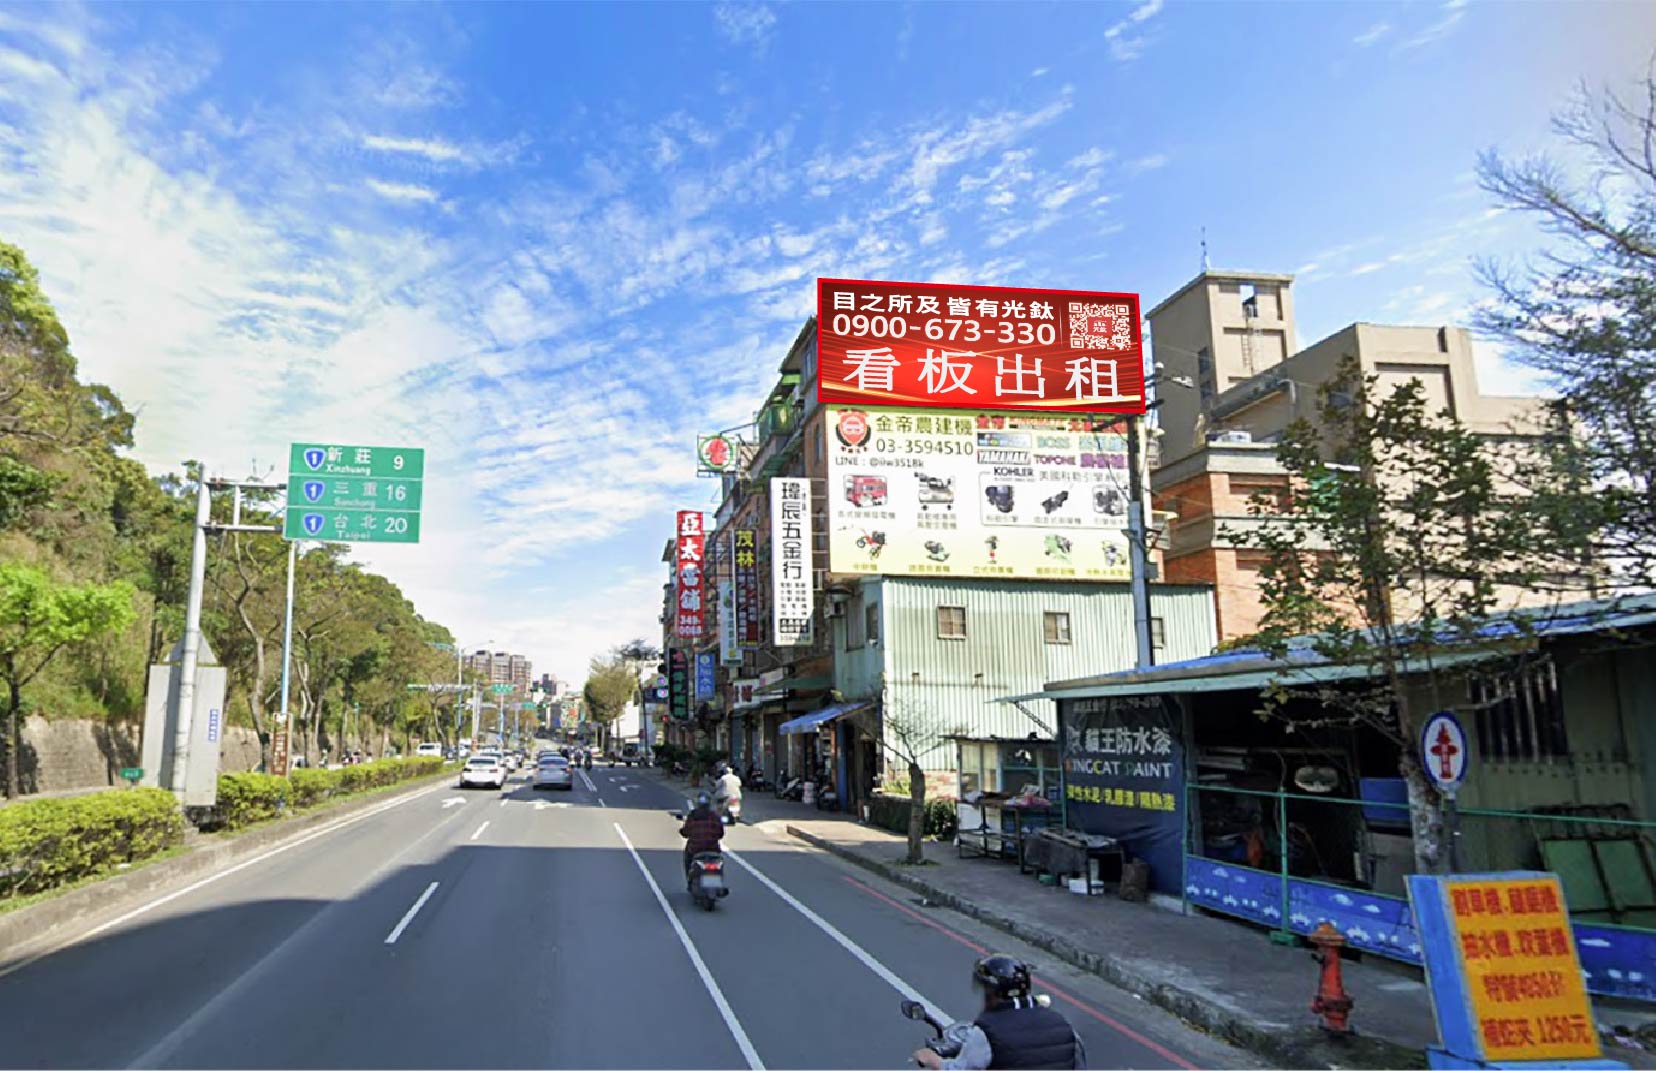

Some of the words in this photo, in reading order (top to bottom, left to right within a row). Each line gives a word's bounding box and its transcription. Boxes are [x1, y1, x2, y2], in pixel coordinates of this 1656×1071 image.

[833, 314, 1056, 346] 0900-673-330
[842, 347, 1124, 402] 看板出租
[876, 415, 973, 436] 金帝農建機
[876, 438, 974, 456] 03-3594510
[393, 455, 404, 470] 9
[994, 466, 1034, 477] KOHLER
[385, 484, 407, 501] 16
[333, 512, 377, 530] 台北
[385, 517, 408, 533] 20
[336, 529, 371, 541] Taipei
[735, 530, 755, 568] 茂林
